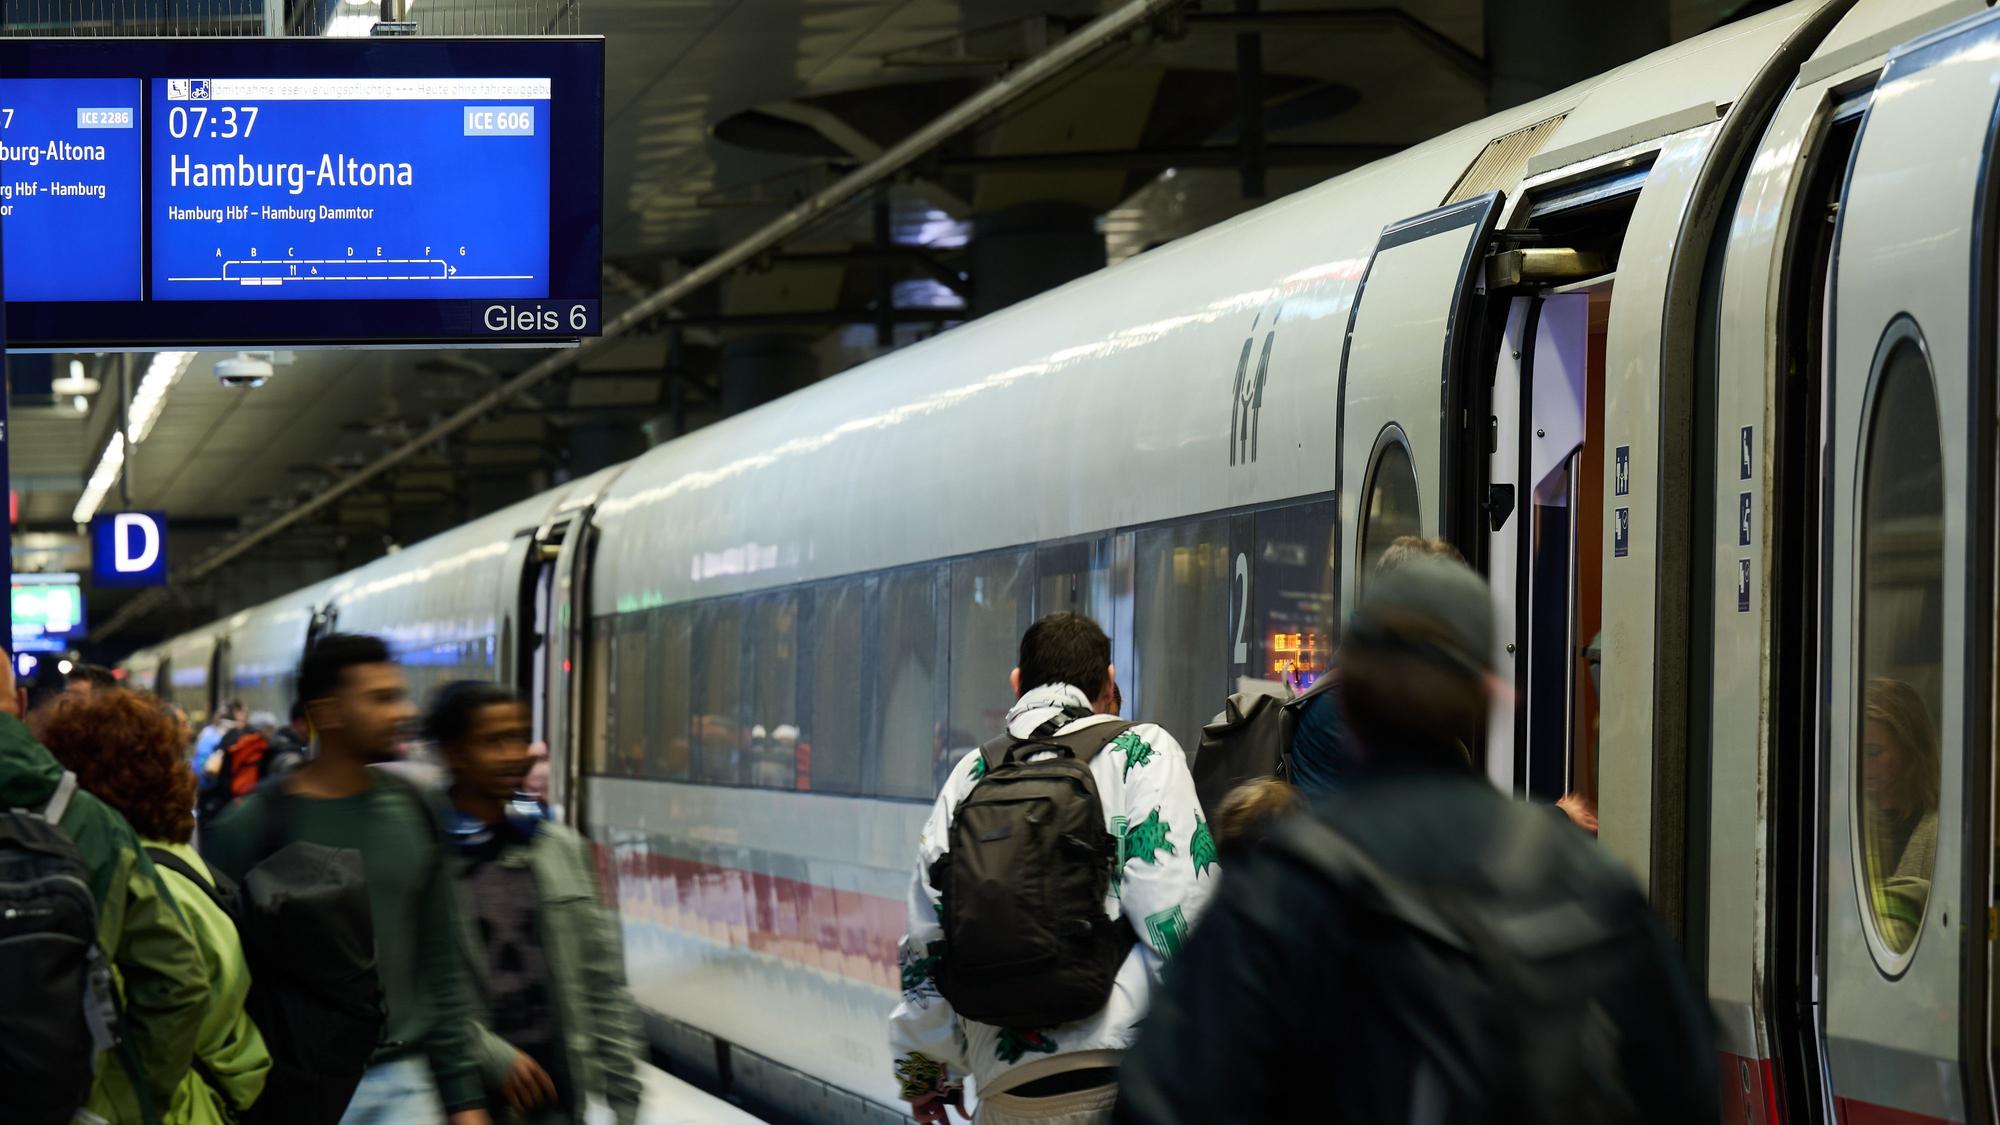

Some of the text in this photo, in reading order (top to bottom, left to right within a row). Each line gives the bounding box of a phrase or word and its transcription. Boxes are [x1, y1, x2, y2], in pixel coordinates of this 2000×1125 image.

[212, 84, 274, 96] dmitnahme
[0, 108, 14, 129] 7
[81, 111, 129, 124] ICE 2286
[168, 106, 259, 138] 07:37
[469, 111, 530, 130] ICE 606
[0, 140, 105, 165] burg-Altona
[170, 153, 413, 195] Hamburg-Altona
[15, 181, 38, 196] Hbf
[51, 181, 106, 199] Hamburg
[168, 205, 224, 224] Hamburg
[226, 205, 249, 220] Hbf
[261, 205, 316, 223] Hamburg
[319, 205, 375, 220] Dammtor
[215, 246, 466, 257] A B C D E F G
[484, 304, 587, 331] Gleis 6
[114, 512, 160, 573] D
[1233, 552, 1249, 664] 2
